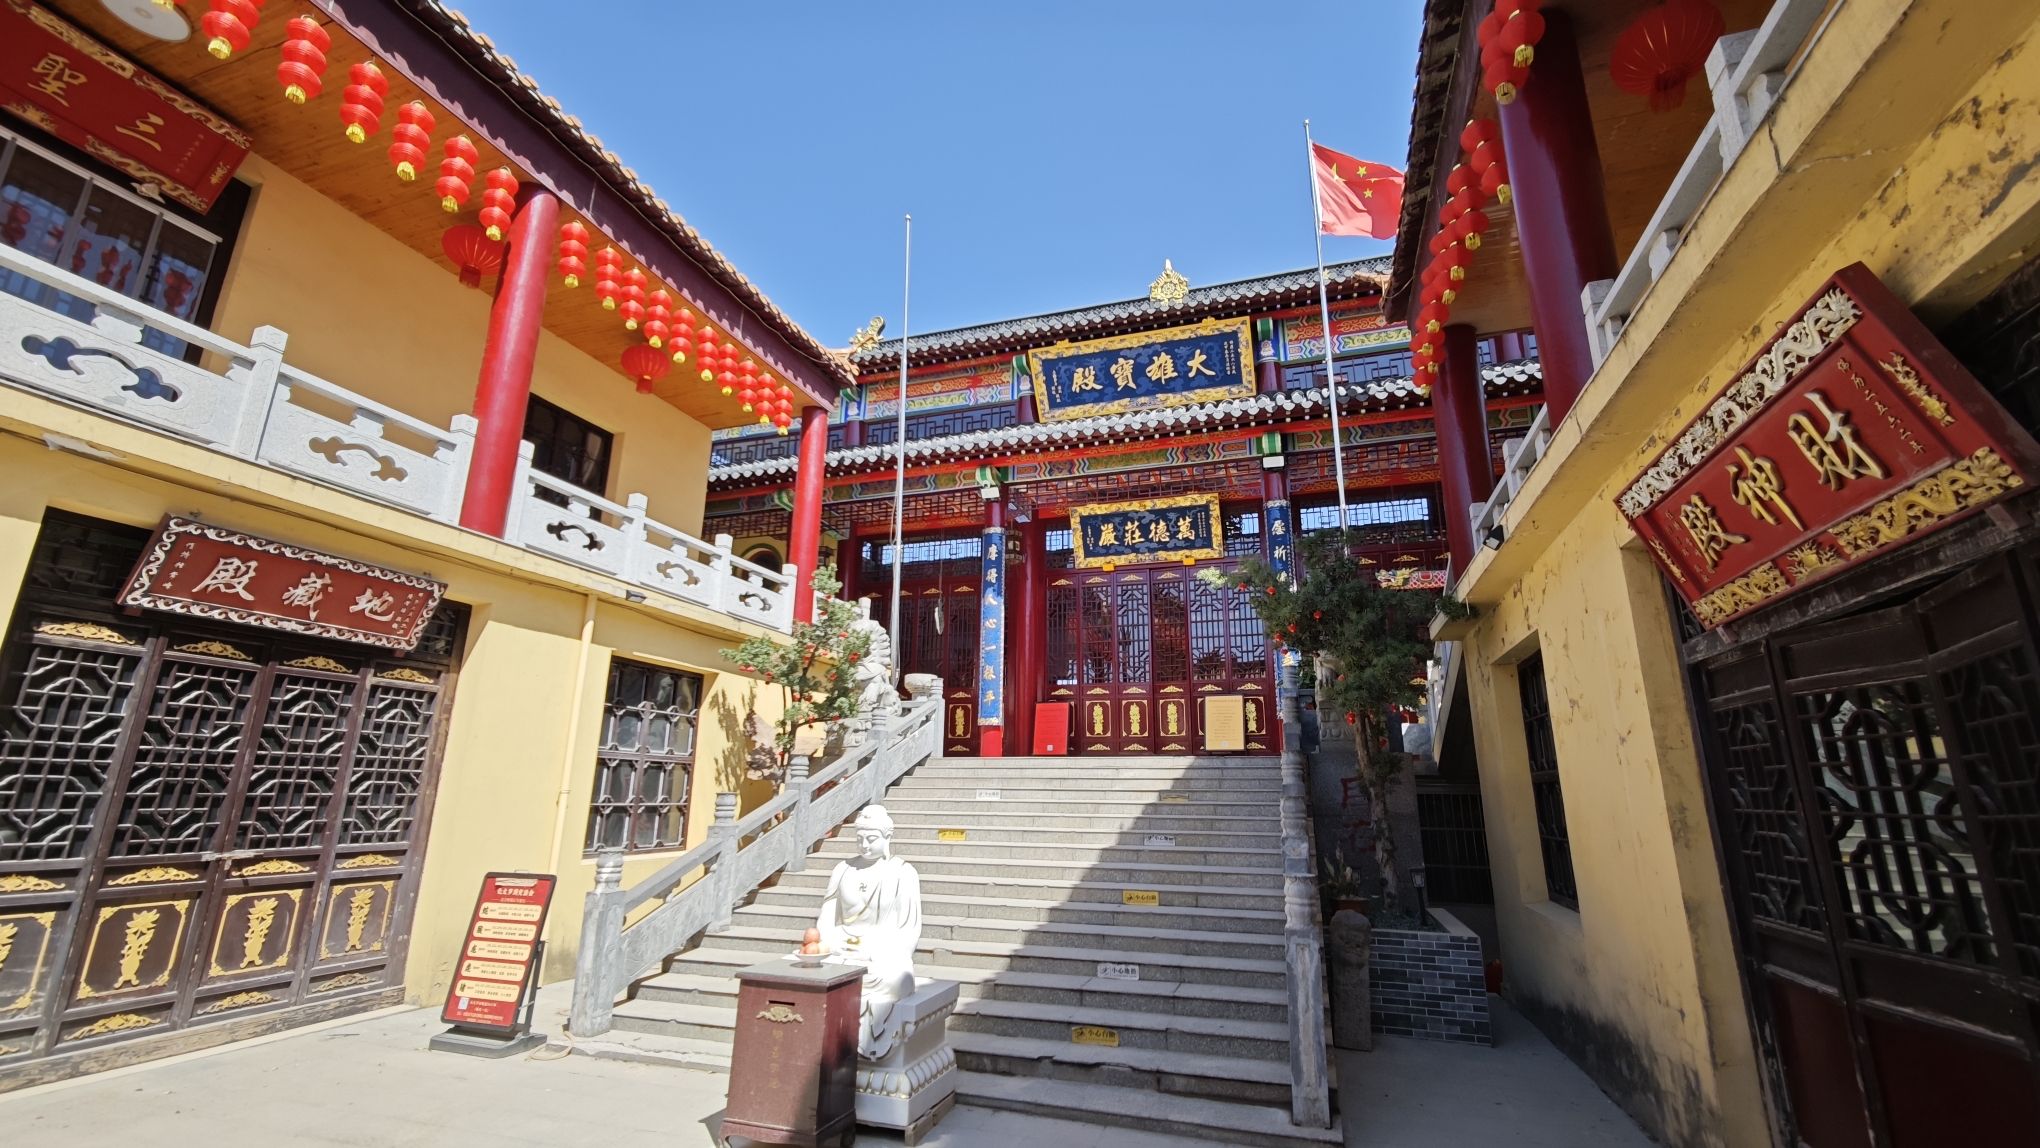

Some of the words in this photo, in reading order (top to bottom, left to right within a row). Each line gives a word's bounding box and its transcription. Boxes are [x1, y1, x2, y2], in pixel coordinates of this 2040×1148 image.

[27, 52, 165, 152] 三聖
[1071, 349, 1216, 394] 大雄寶殿
[1679, 388, 1887, 571] 財神殿
[1098, 515, 1196, 547] 萬德莊嚴
[191, 556, 396, 622] 地藏殿
